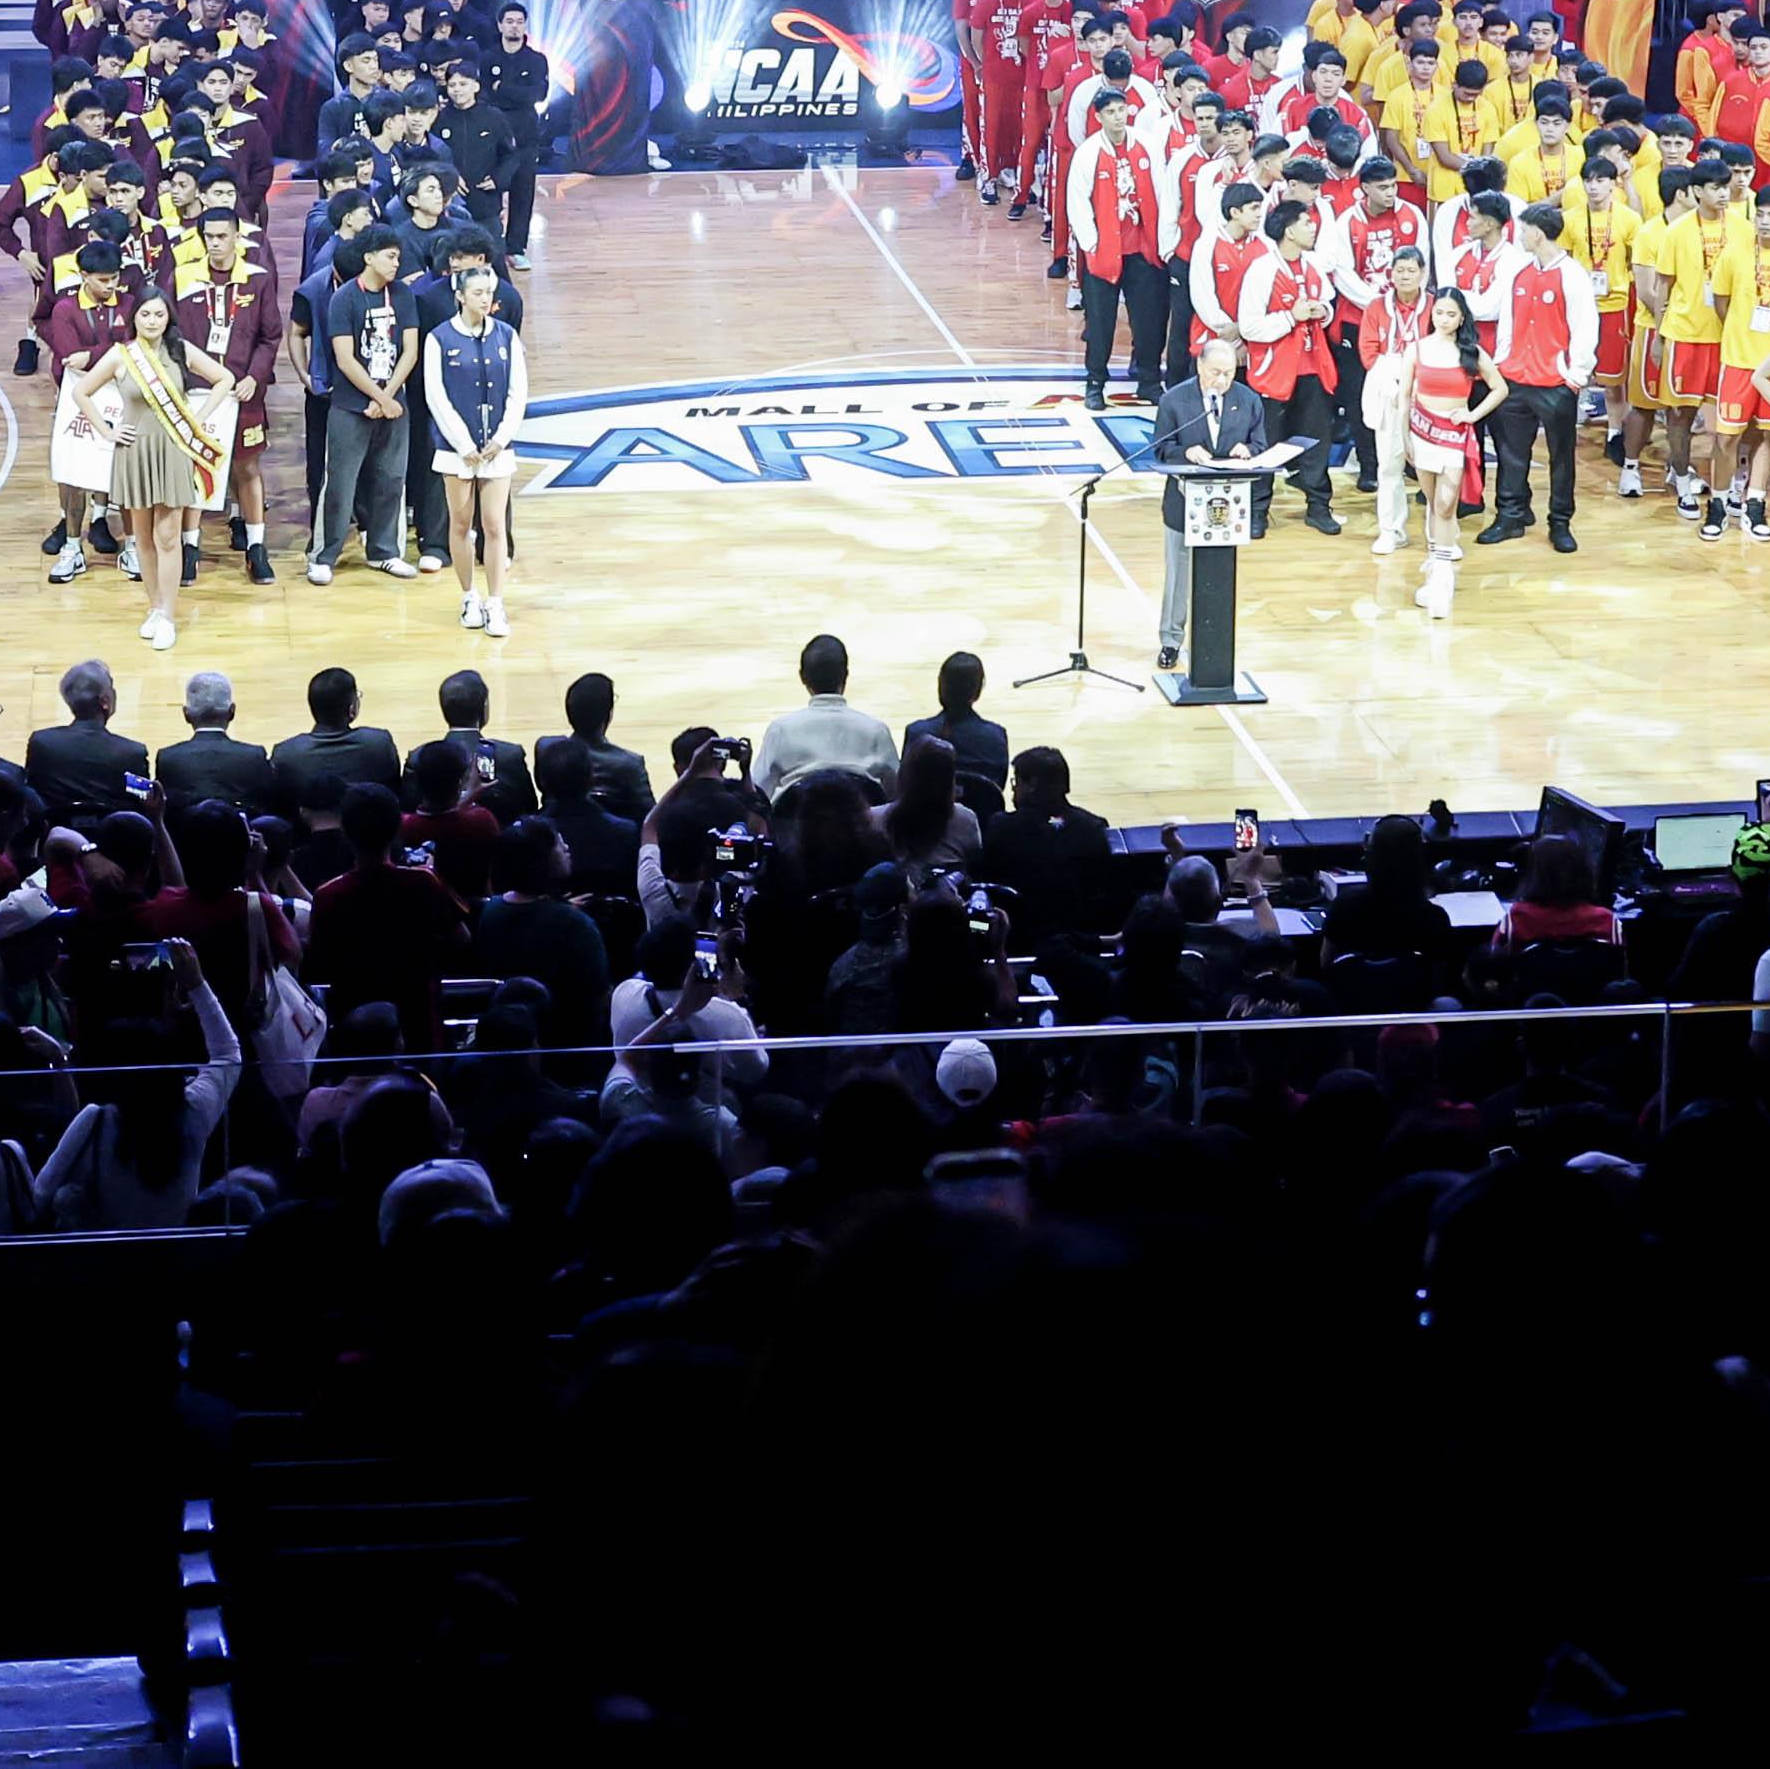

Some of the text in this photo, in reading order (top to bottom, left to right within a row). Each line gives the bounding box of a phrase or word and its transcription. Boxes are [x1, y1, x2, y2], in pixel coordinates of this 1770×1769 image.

[707, 103, 859, 119] HILIPPINES
[686, 404, 883, 418] MALL
[910, 400, 1009, 413] OF
